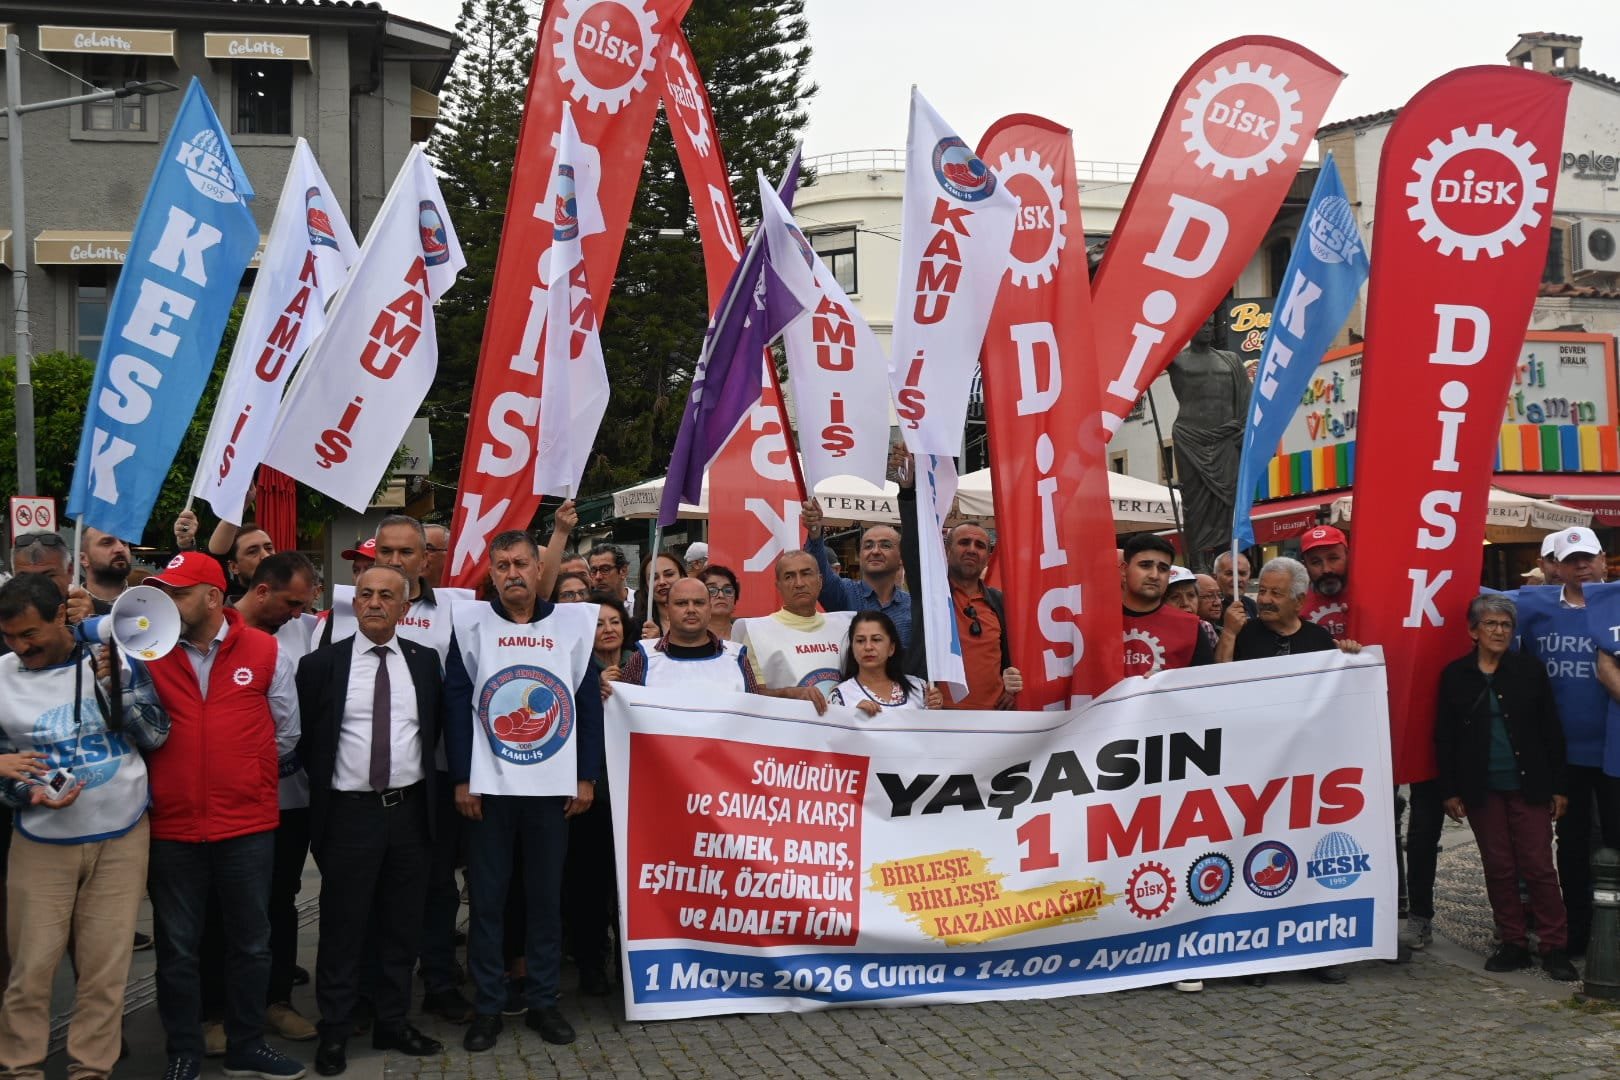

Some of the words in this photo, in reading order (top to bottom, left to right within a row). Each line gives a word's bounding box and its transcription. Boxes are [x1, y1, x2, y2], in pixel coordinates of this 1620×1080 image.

[176, 142, 235, 192] KES
[1437, 169, 1518, 206] DİSK
[1017, 196, 1051, 231] İSK
[913, 196, 975, 326] KAMU
[812, 277, 857, 372] AMU
[88, 205, 223, 505] KESK
[314, 396, 364, 469] İŞ
[821, 391, 855, 458] İŞ
[1402, 303, 1491, 628] DİSK
[498, 636, 554, 651] KAMU-İŞ
[796, 642, 839, 655] KAMU-İŞ
[751, 758, 860, 796] SÖMÜRÜYE
[877, 728, 1223, 820] YAŞASIN
[686, 793, 712, 815] ve
[716, 792, 791, 827] SAVAŞA
[796, 802, 856, 832] KARŞI
[1016, 813, 1060, 872] 1
[1086, 767, 1366, 862] MAYIS
[693, 832, 779, 866] EKMEK,
[783, 840, 855, 871] BARIŞ,
[881, 857, 973, 884] BİRLEŞE
[1306, 854, 1372, 878] KESK
[639, 861, 729, 900] EŞİTLİK,
[735, 868, 854, 902] ÖZGÜRLÜK
[907, 879, 1000, 910] BİRLEŞE
[1136, 880, 1166, 899] DİSK
[1328, 877, 1348, 886] 1995
[679, 908, 705, 928] ve
[709, 908, 802, 936] ADALET
[803, 907, 852, 940] İÇİN
[933, 886, 1103, 937] KAZANACAĞIZ!
[645, 964, 660, 991] 1
[670, 962, 764, 990] Mayıs
[773, 966, 853, 993] 2026
[860, 963, 945, 987] Cuma
[976, 954, 1063, 982] 14.00
[1088, 941, 1170, 972] Aydın
[1177, 922, 1271, 958] Kanza
[1276, 913, 1357, 947] Parkı
